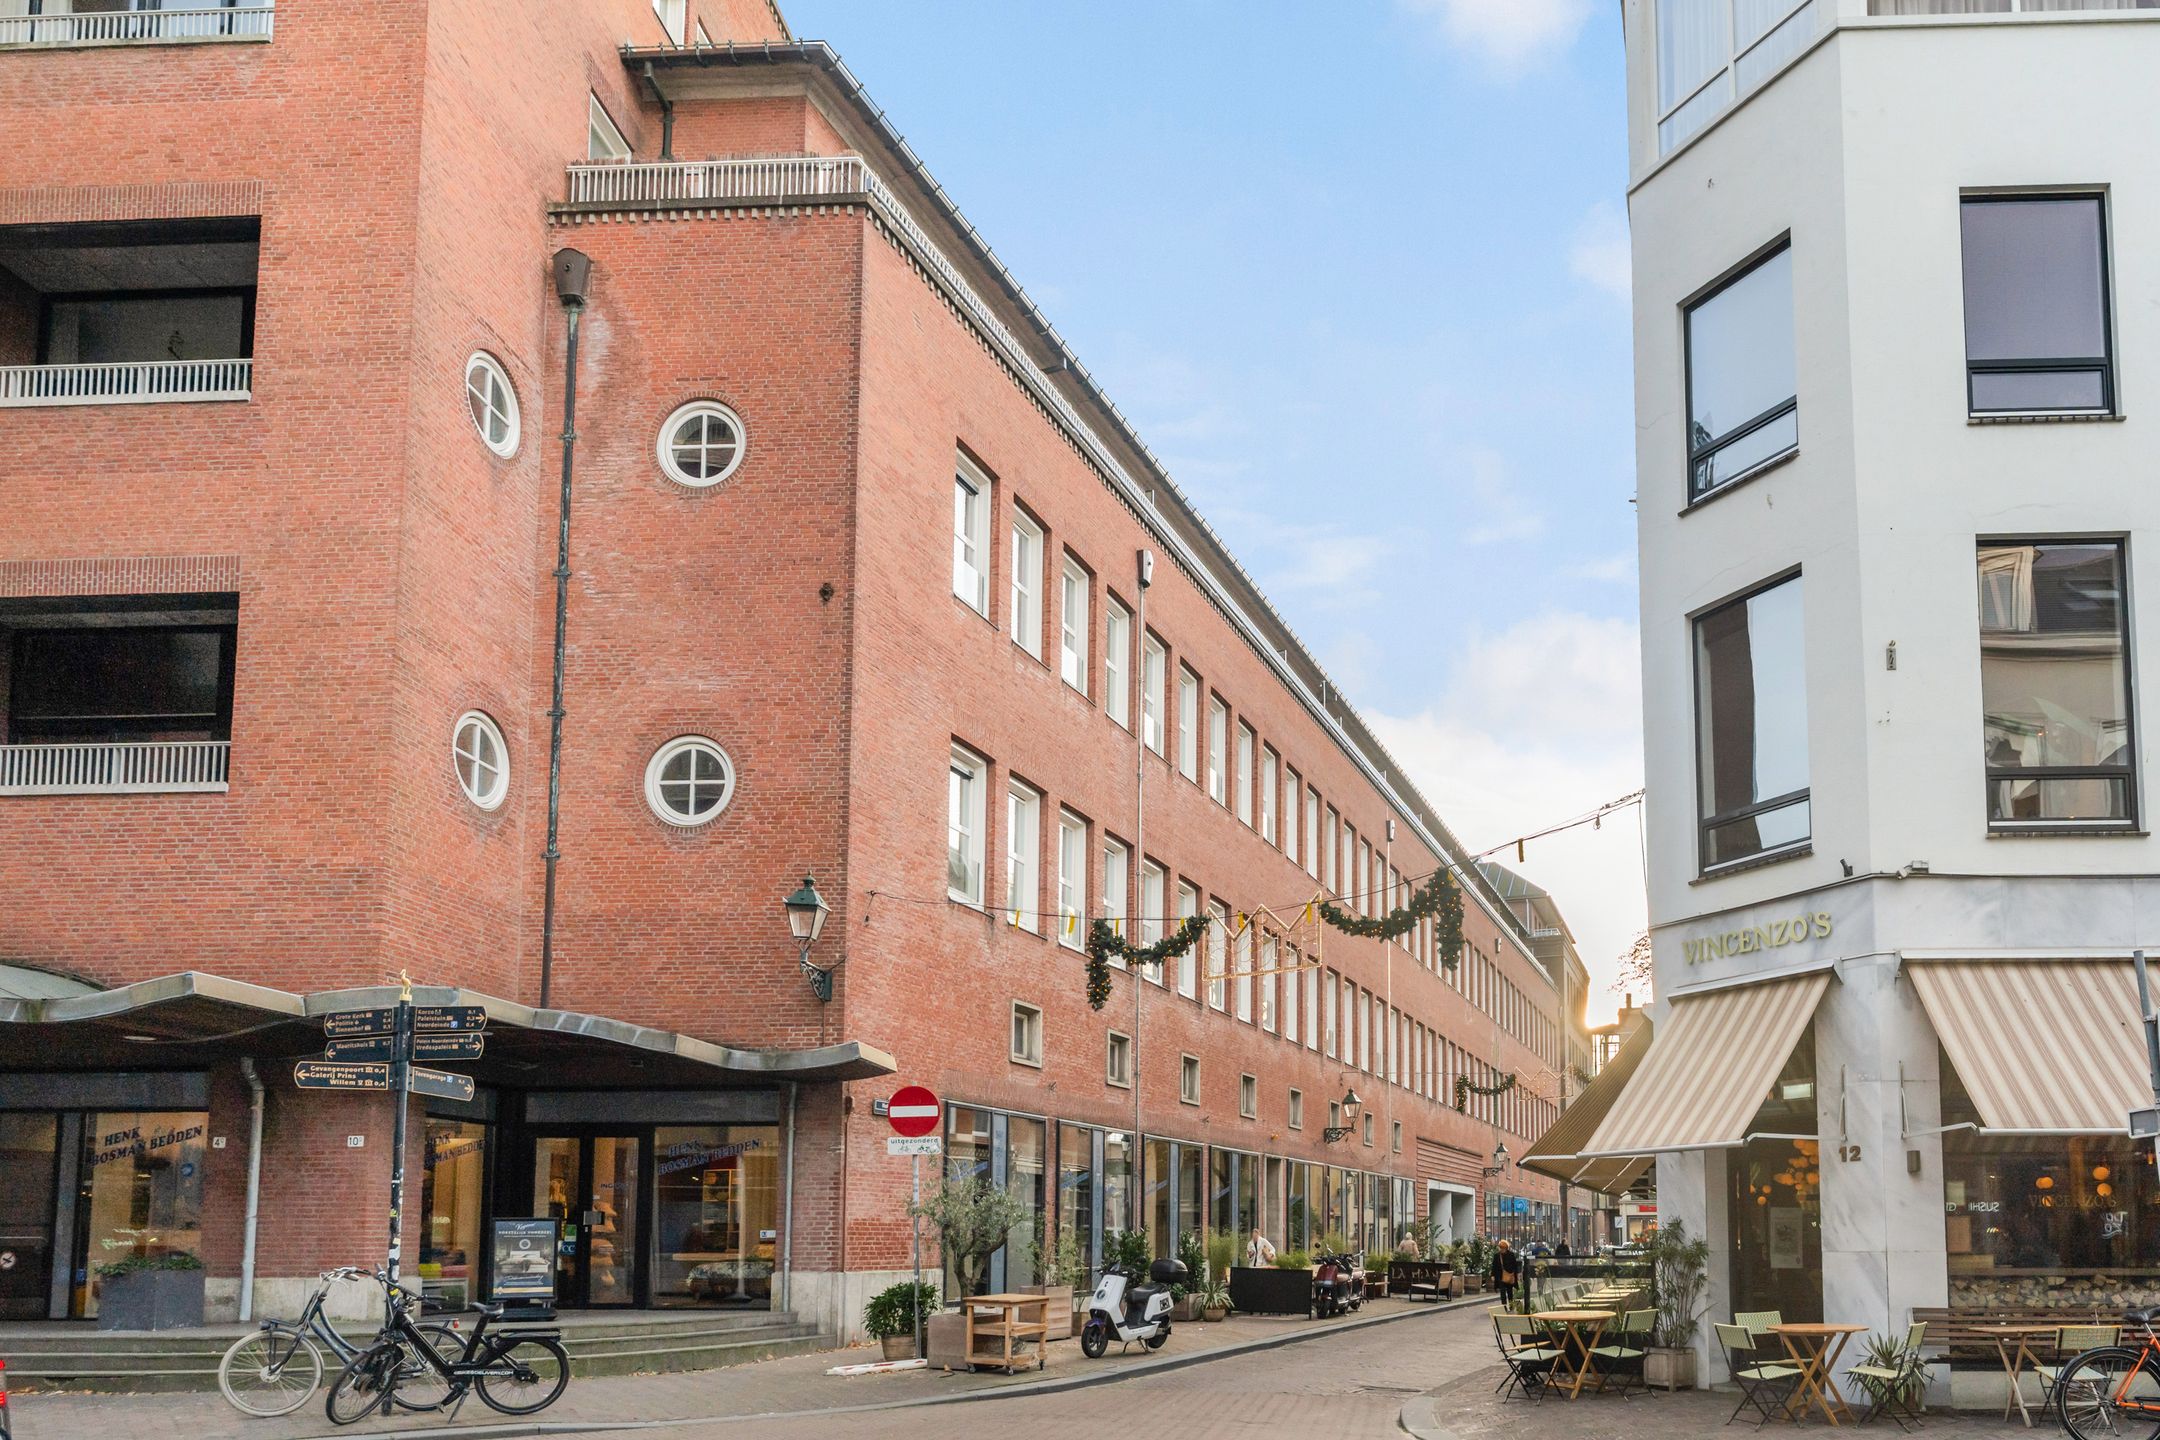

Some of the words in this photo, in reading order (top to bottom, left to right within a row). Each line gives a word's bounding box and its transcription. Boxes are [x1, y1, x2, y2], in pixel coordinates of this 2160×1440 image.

[1681, 911, 1832, 966] VINCENZO'S
[336, 1041, 369, 1049] Mauritshuis
[310, 1065, 364, 1074] Gevangenpoort
[310, 1071, 336, 1079] Galerij
[104, 1126, 141, 1147] HENK
[149, 1125, 203, 1150] BEDDEN
[1838, 1145, 1862, 1163] 12
